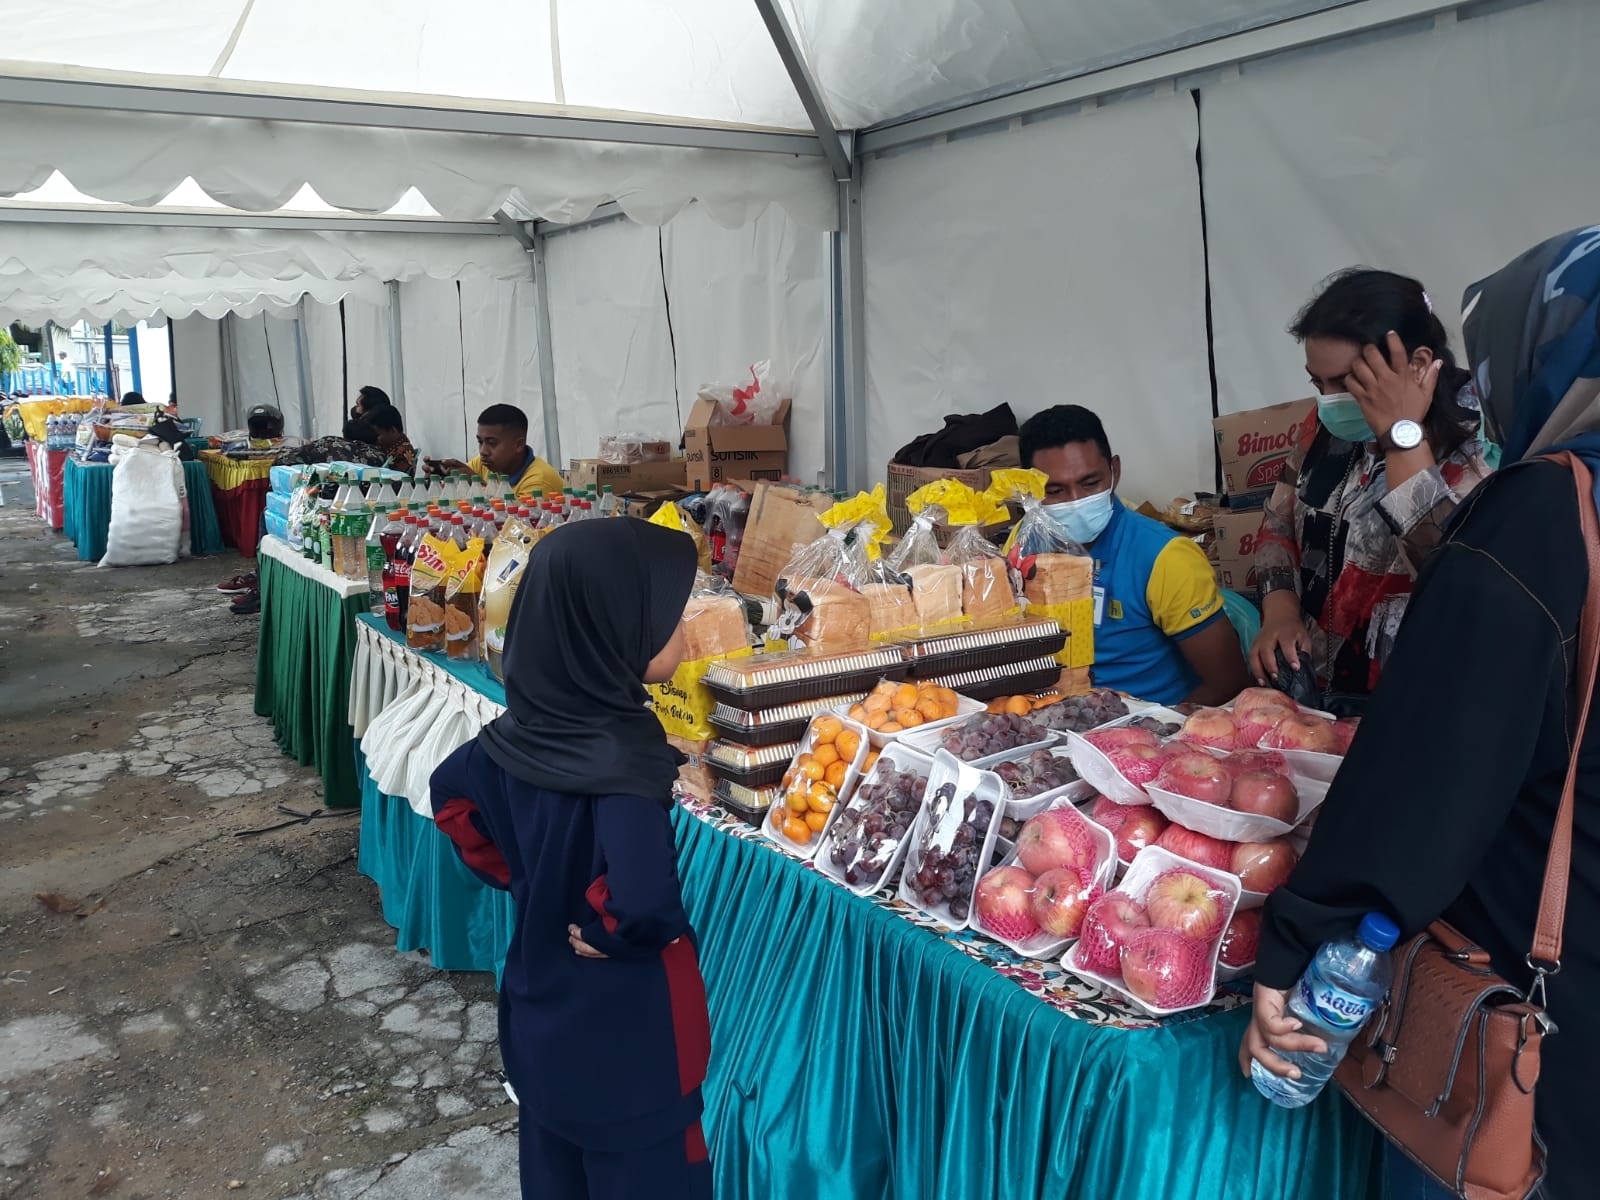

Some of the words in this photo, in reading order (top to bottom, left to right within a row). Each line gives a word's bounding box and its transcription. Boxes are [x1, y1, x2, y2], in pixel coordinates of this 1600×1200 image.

[1237, 424, 1297, 457] Bimol
[385, 592, 398, 603] FAN
[659, 681, 687, 704] Disney
[1320, 990, 1367, 1016] AQUA
